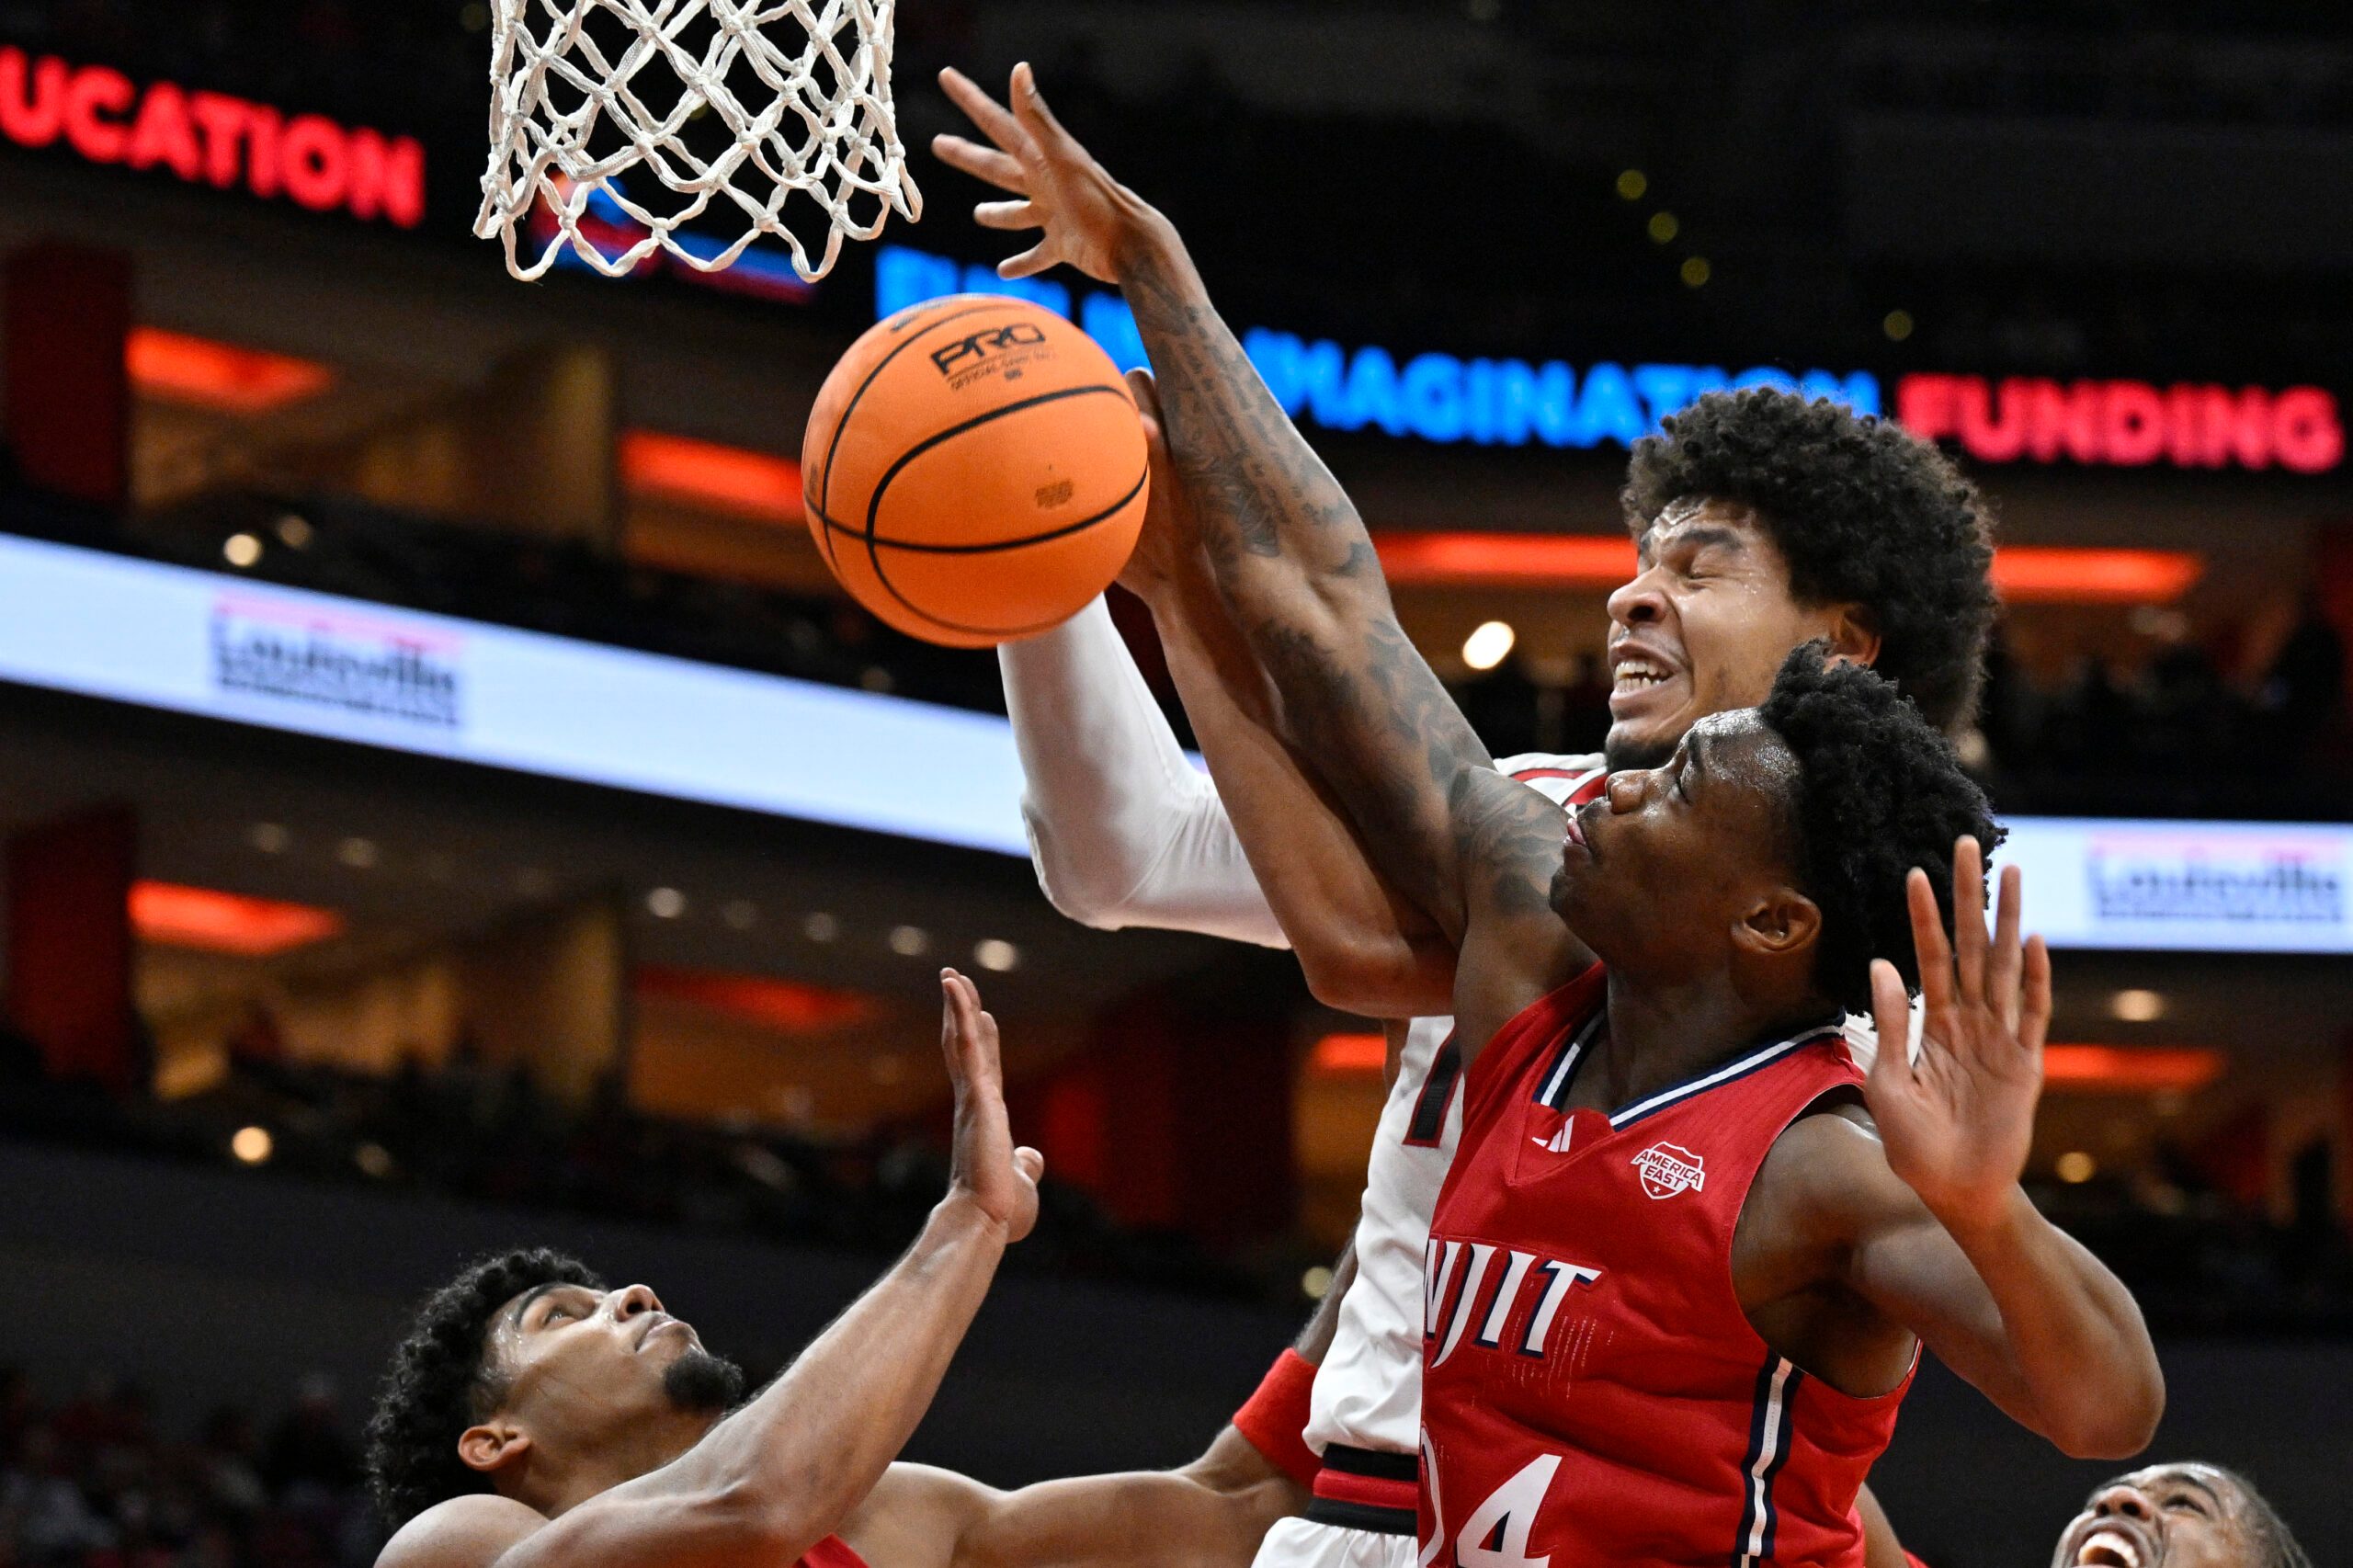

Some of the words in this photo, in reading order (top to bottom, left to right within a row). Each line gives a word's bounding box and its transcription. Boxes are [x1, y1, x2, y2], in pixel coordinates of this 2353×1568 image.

[930, 323, 1045, 374] PRO
[1243, 326, 1881, 448] MAGINAT
[1899, 371, 2344, 472] FUNDING
[1635, 1151, 1701, 1187] AMERICA
[1644, 1165, 1683, 1187] EAST
[1425, 1239, 1602, 1369] NJIT
